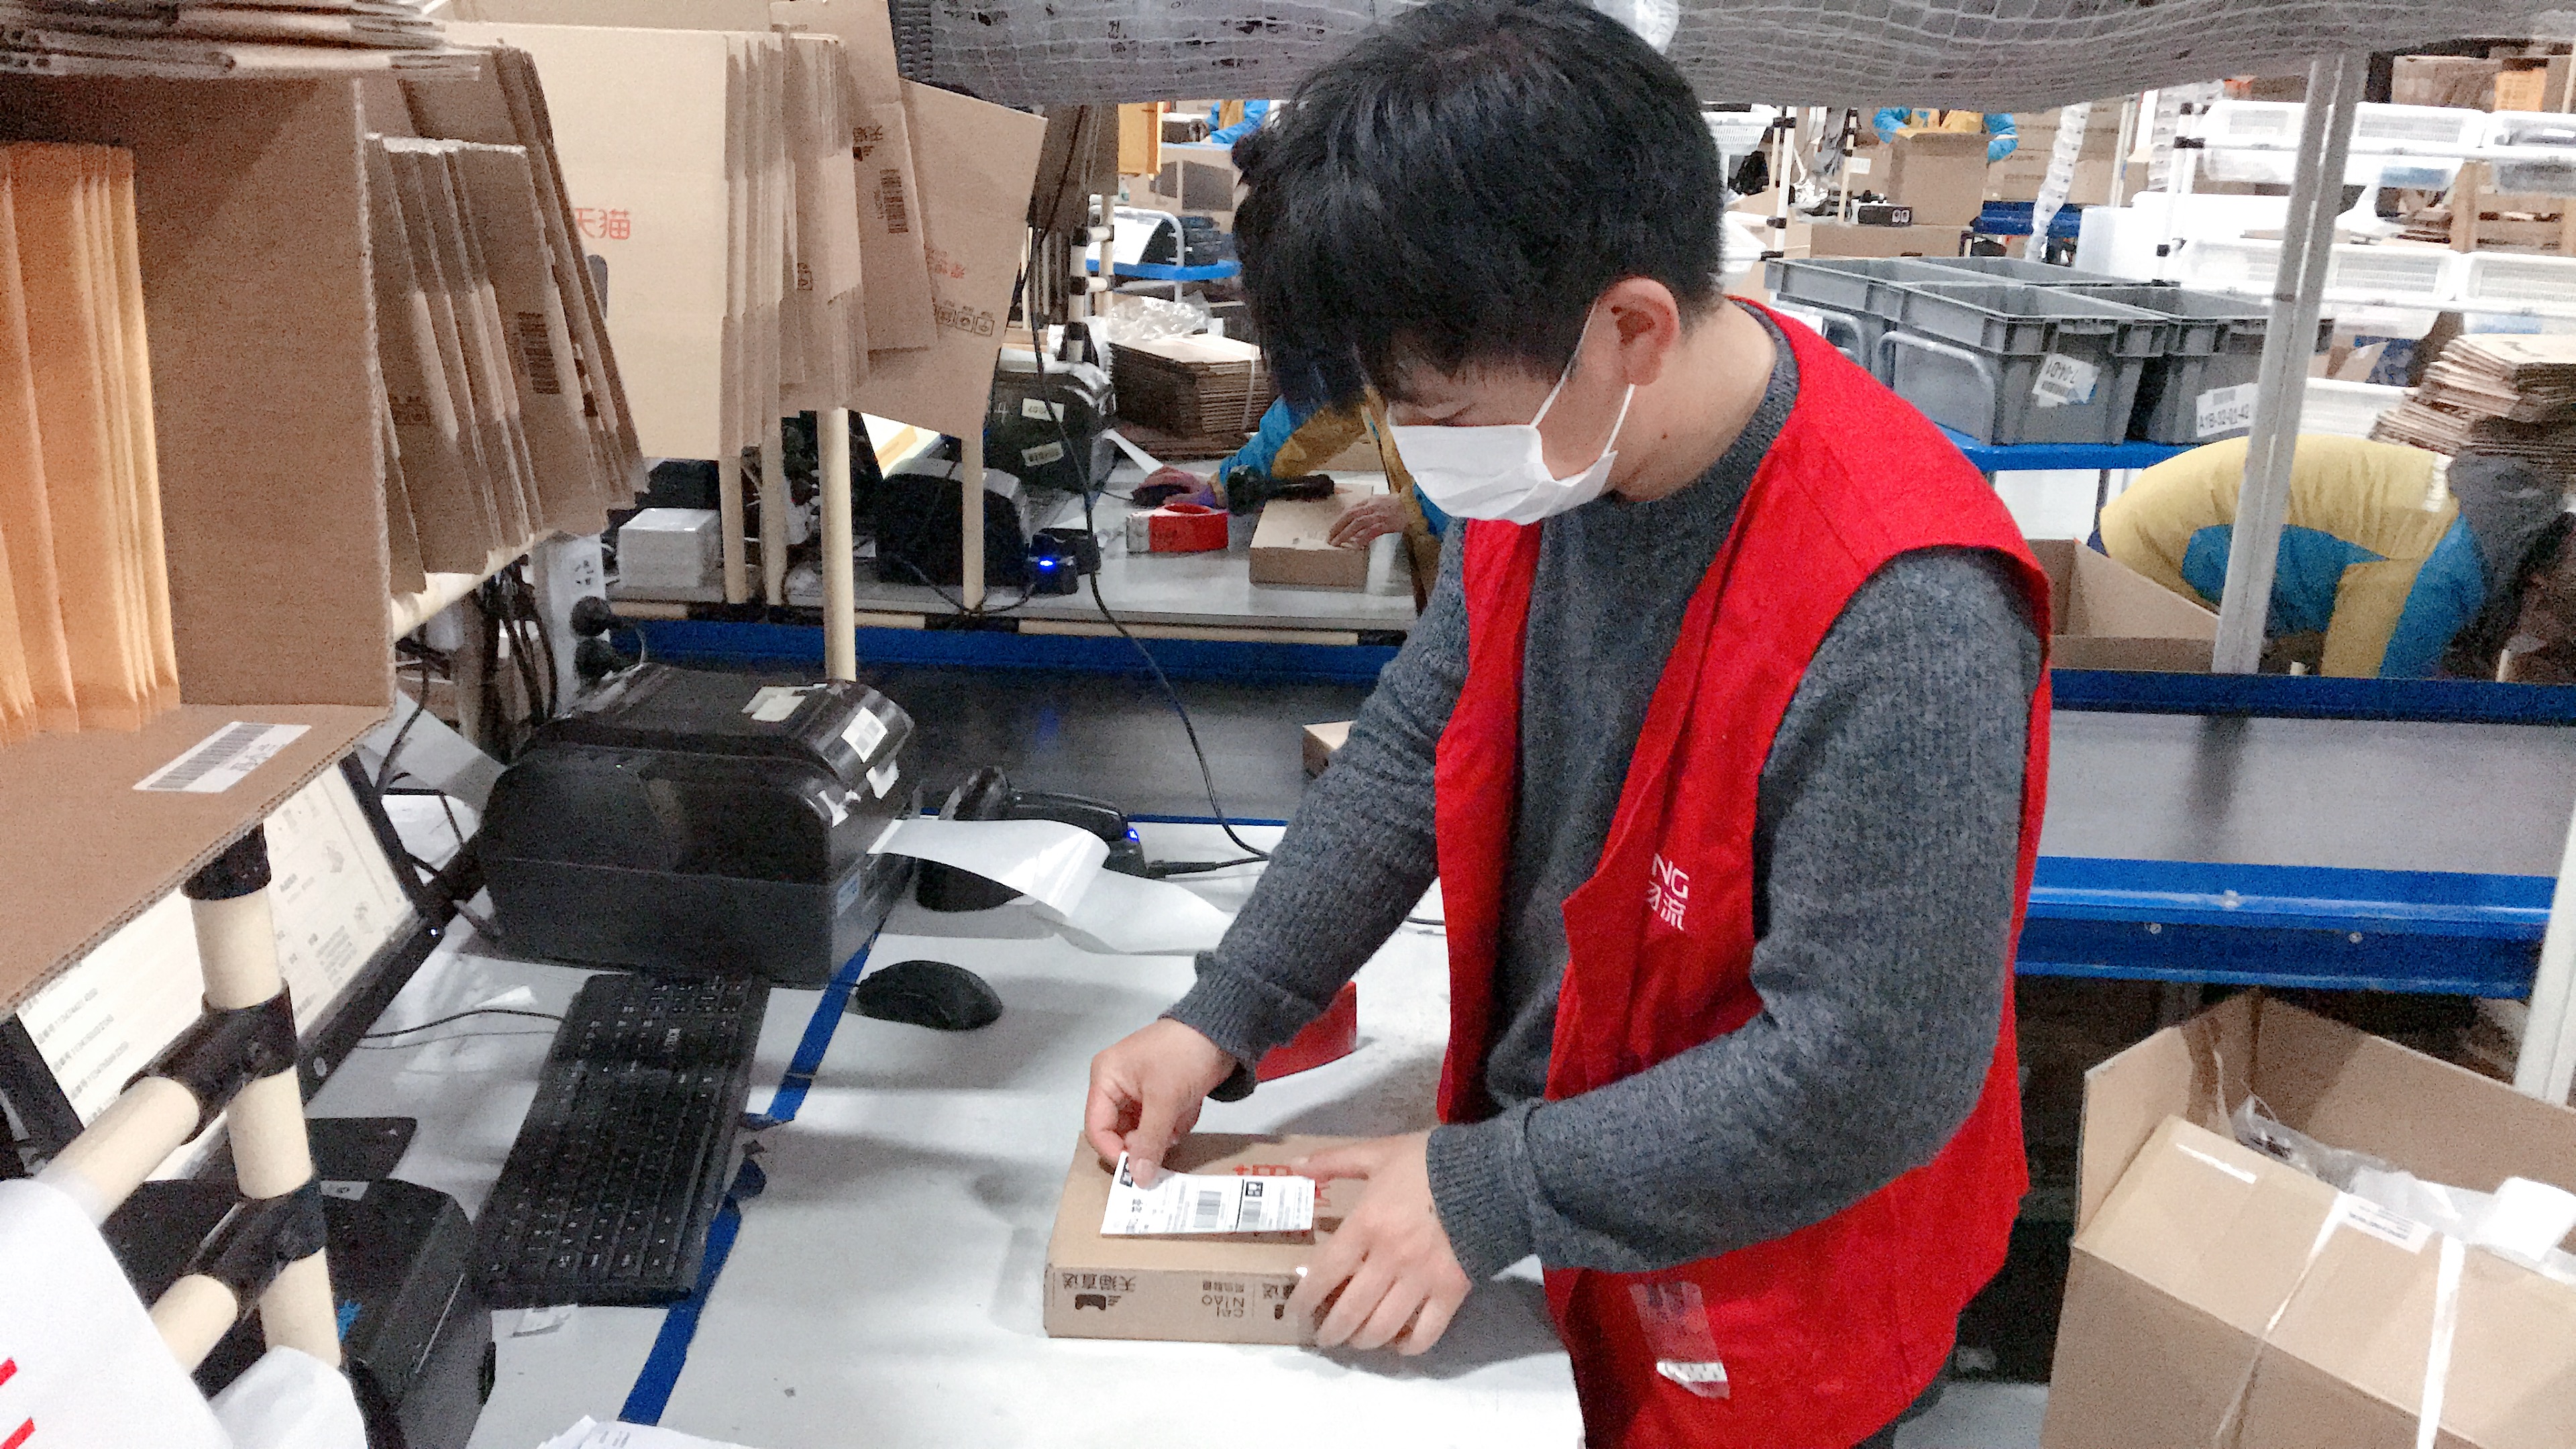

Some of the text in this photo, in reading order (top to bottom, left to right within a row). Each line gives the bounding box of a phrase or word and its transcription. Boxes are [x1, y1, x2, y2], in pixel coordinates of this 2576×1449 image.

[574, 207, 631, 239] 天猫
[1651, 852, 1690, 900] NG
[1063, 1274, 1136, 1292] 天猫直送
[1202, 1295, 1244, 1307] NIAO
